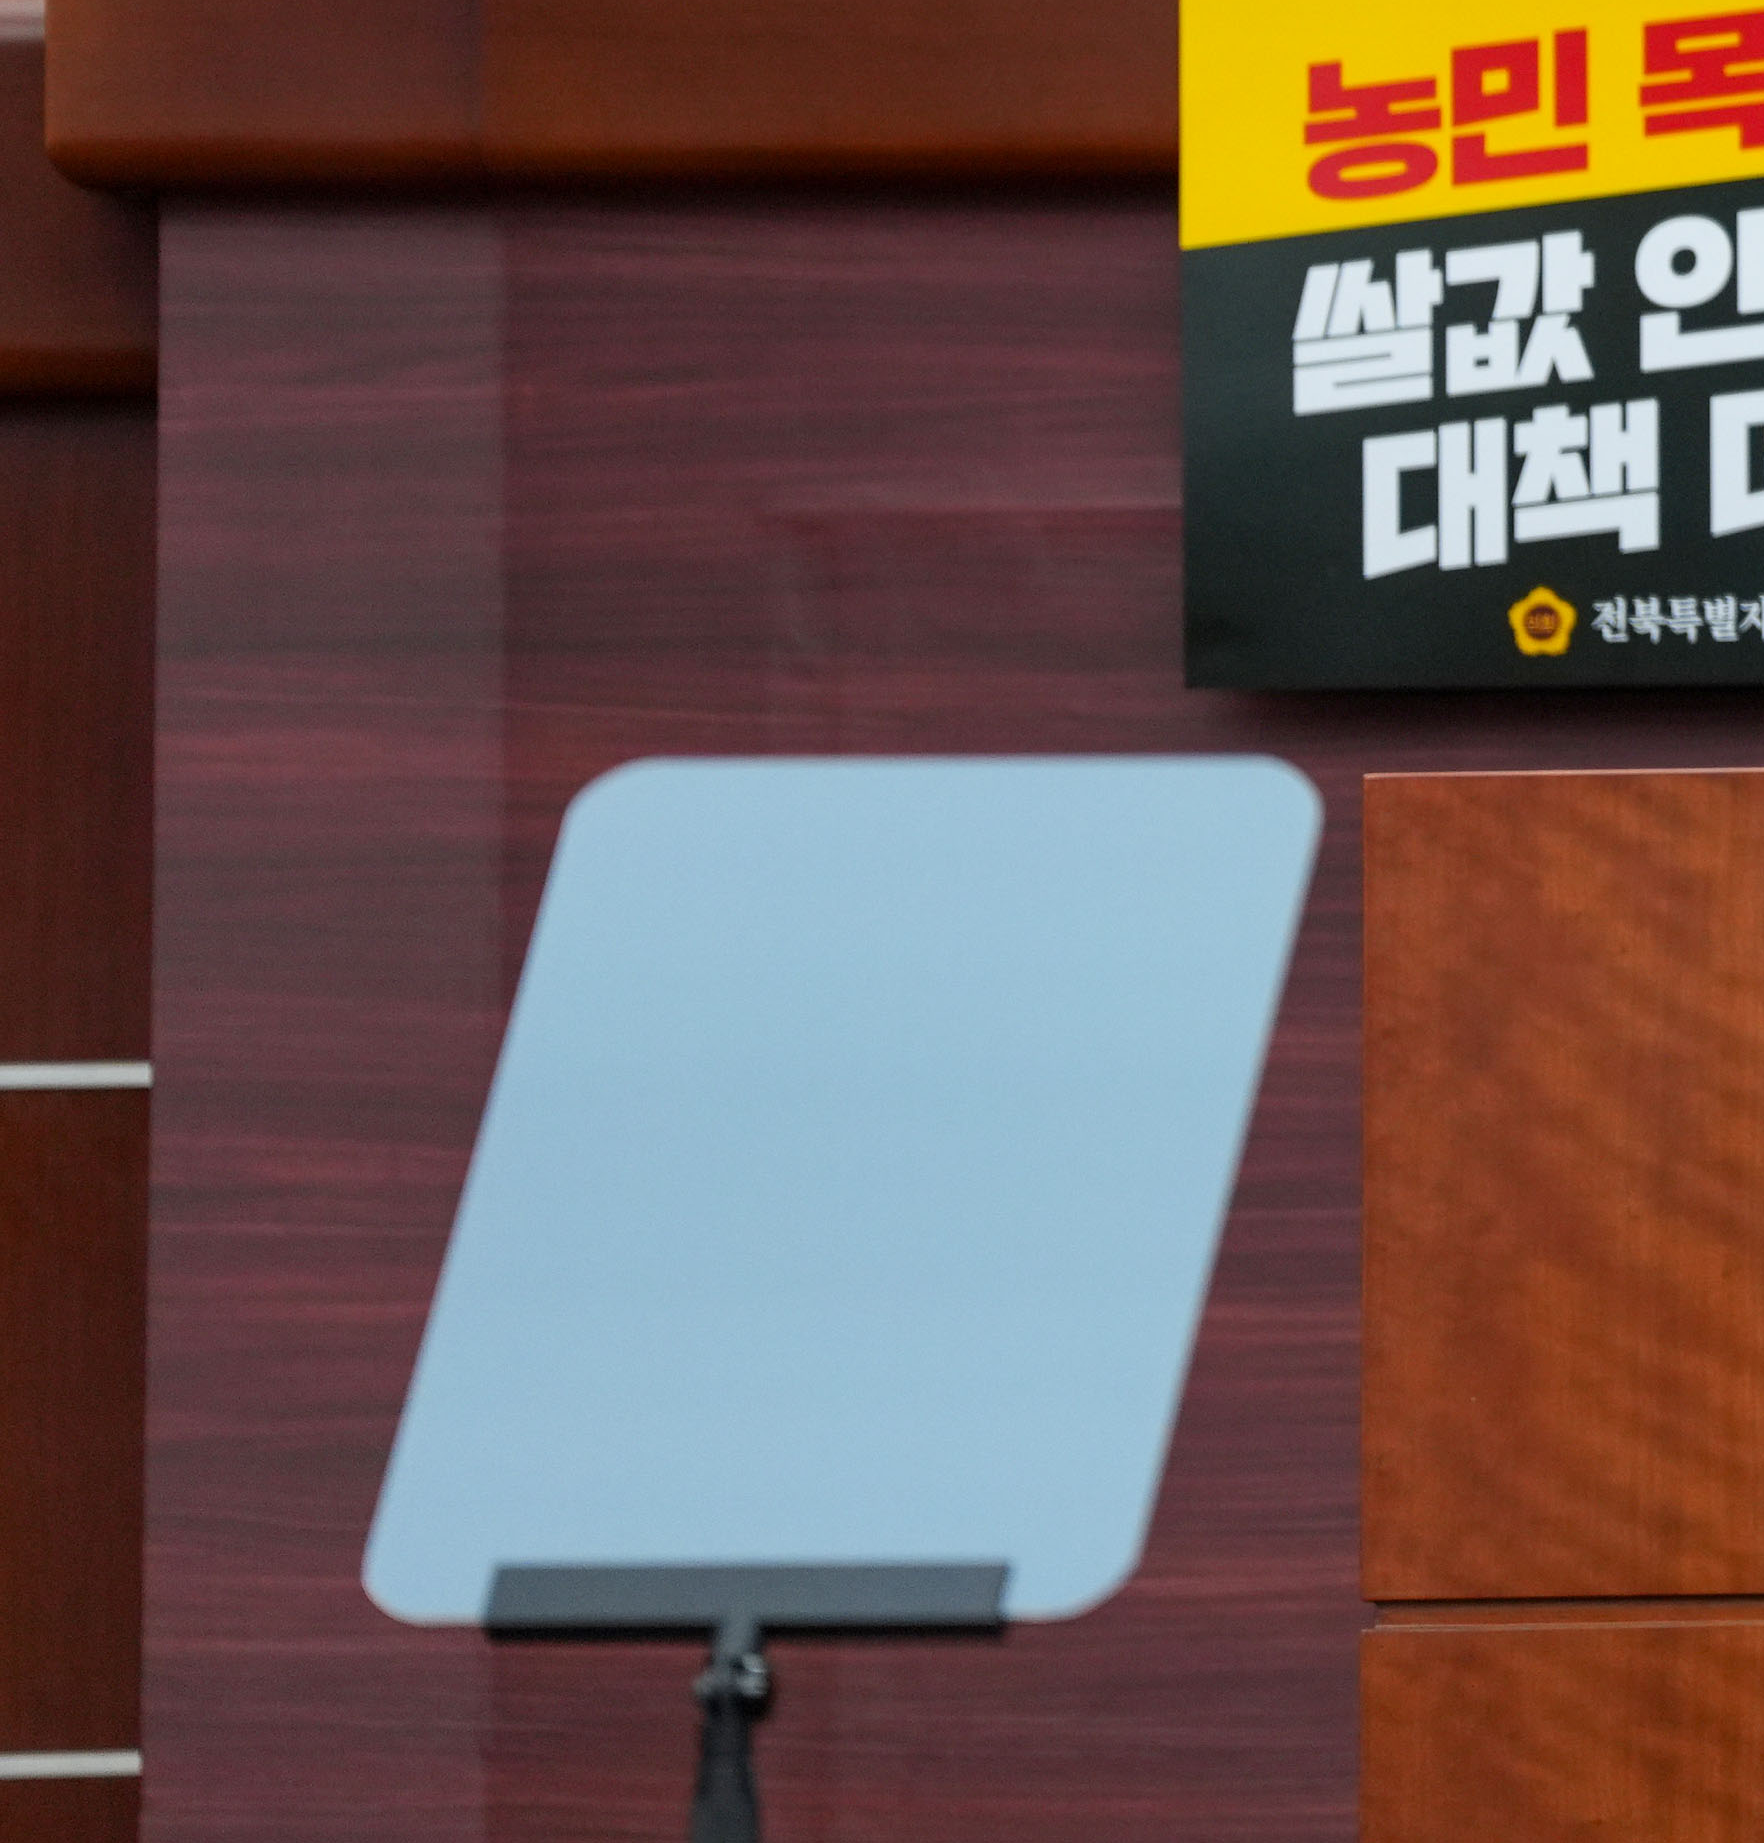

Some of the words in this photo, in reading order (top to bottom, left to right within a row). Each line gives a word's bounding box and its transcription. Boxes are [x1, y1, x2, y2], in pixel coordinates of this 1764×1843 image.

[1305, 29, 1588, 199] 농민
[1294, 232, 1594, 413] 쌀값
[1364, 399, 1658, 577] 대책
